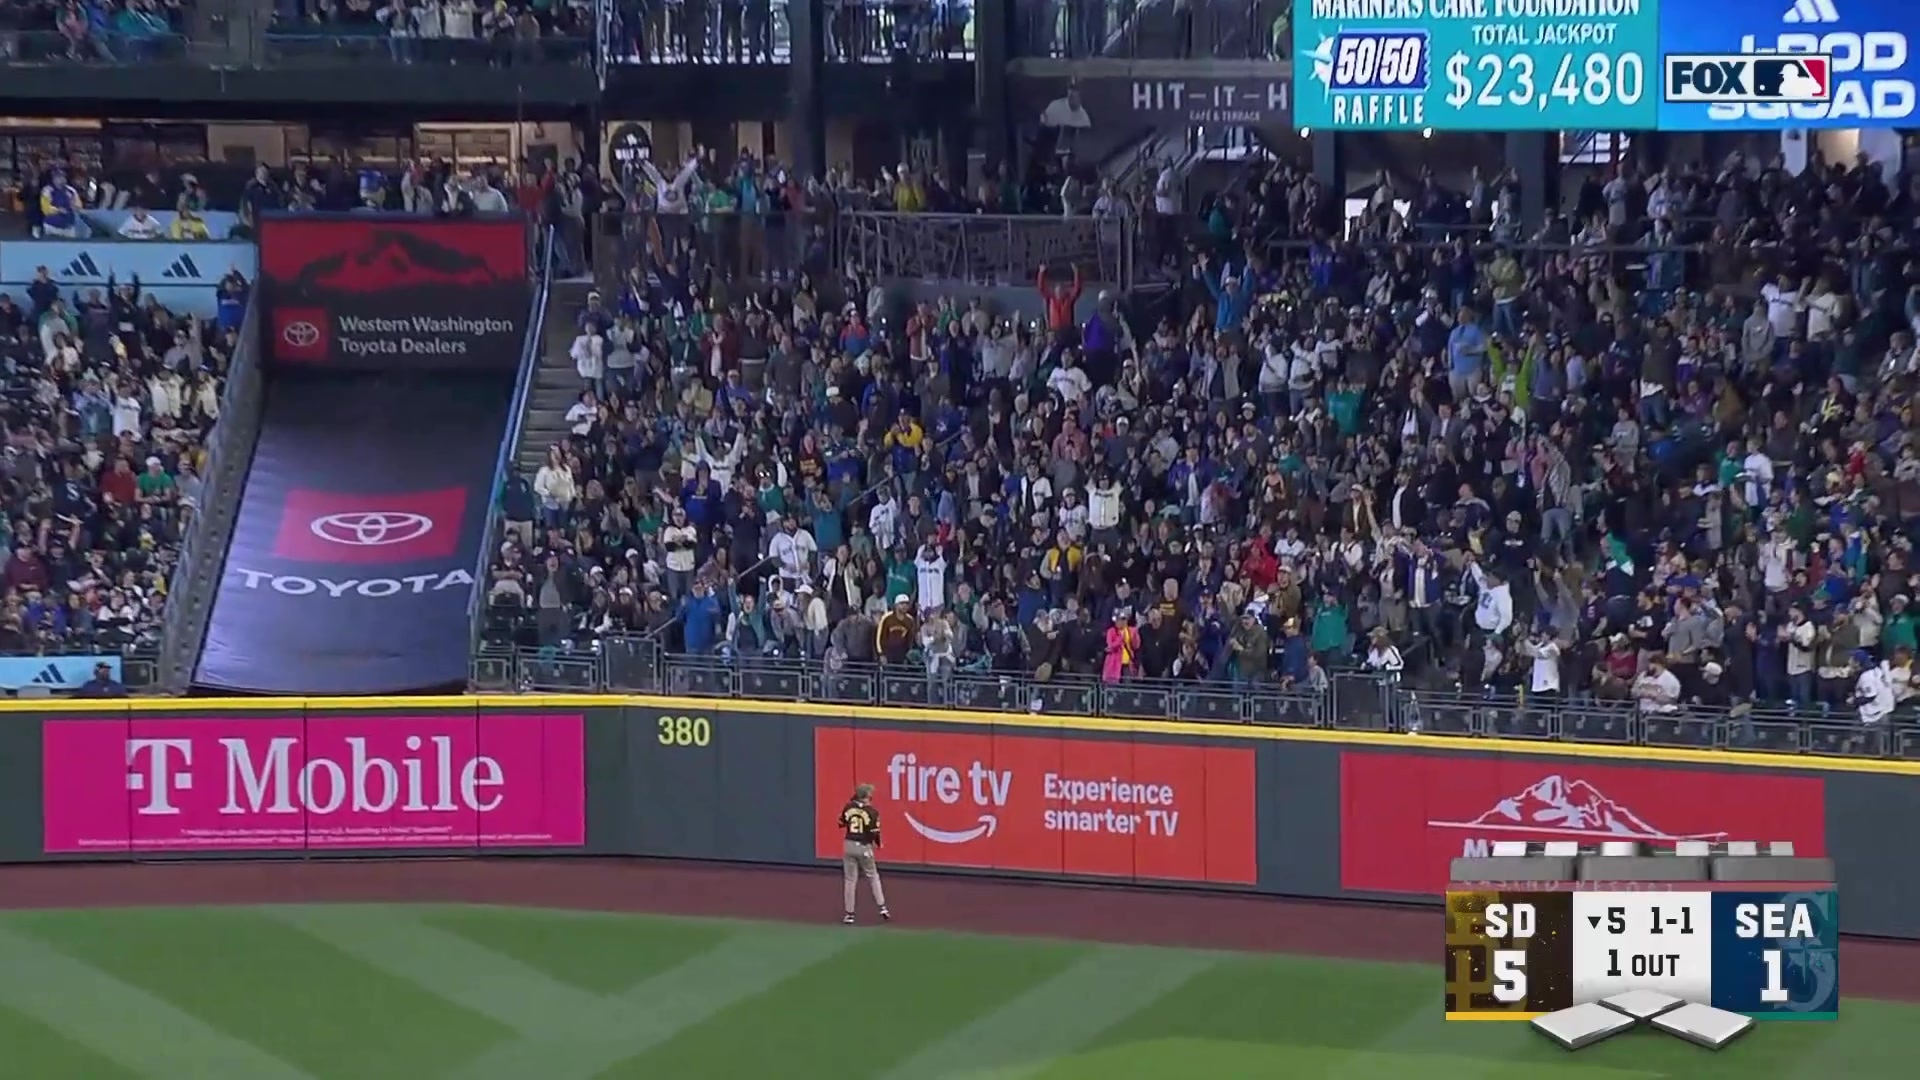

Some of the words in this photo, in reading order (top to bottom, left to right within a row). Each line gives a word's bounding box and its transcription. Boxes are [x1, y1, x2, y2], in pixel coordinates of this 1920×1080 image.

[1472, 24, 1530, 45] TOTAL
[1533, 23, 1617, 45] JACKPOT
[1335, 36, 1422, 86] 50/50
[1446, 50, 1644, 112] $23,480
[1334, 95, 1424, 125] RAFFLE
[339, 316, 410, 333] Western
[412, 316, 513, 336] Washington
[339, 337, 398, 358] Toyota
[400, 337, 467, 354] Dealers
[236, 568, 475, 597] TOYOTA
[658, 716, 710, 746] 380
[218, 736, 504, 815] Mobile
[887, 753, 960, 804] fire
[969, 760, 1012, 807] tv
[1044, 773, 1174, 806] Experience
[850, 816, 863, 833] 21
[1044, 808, 1141, 835] smarter
[1145, 810, 1178, 837] TV
